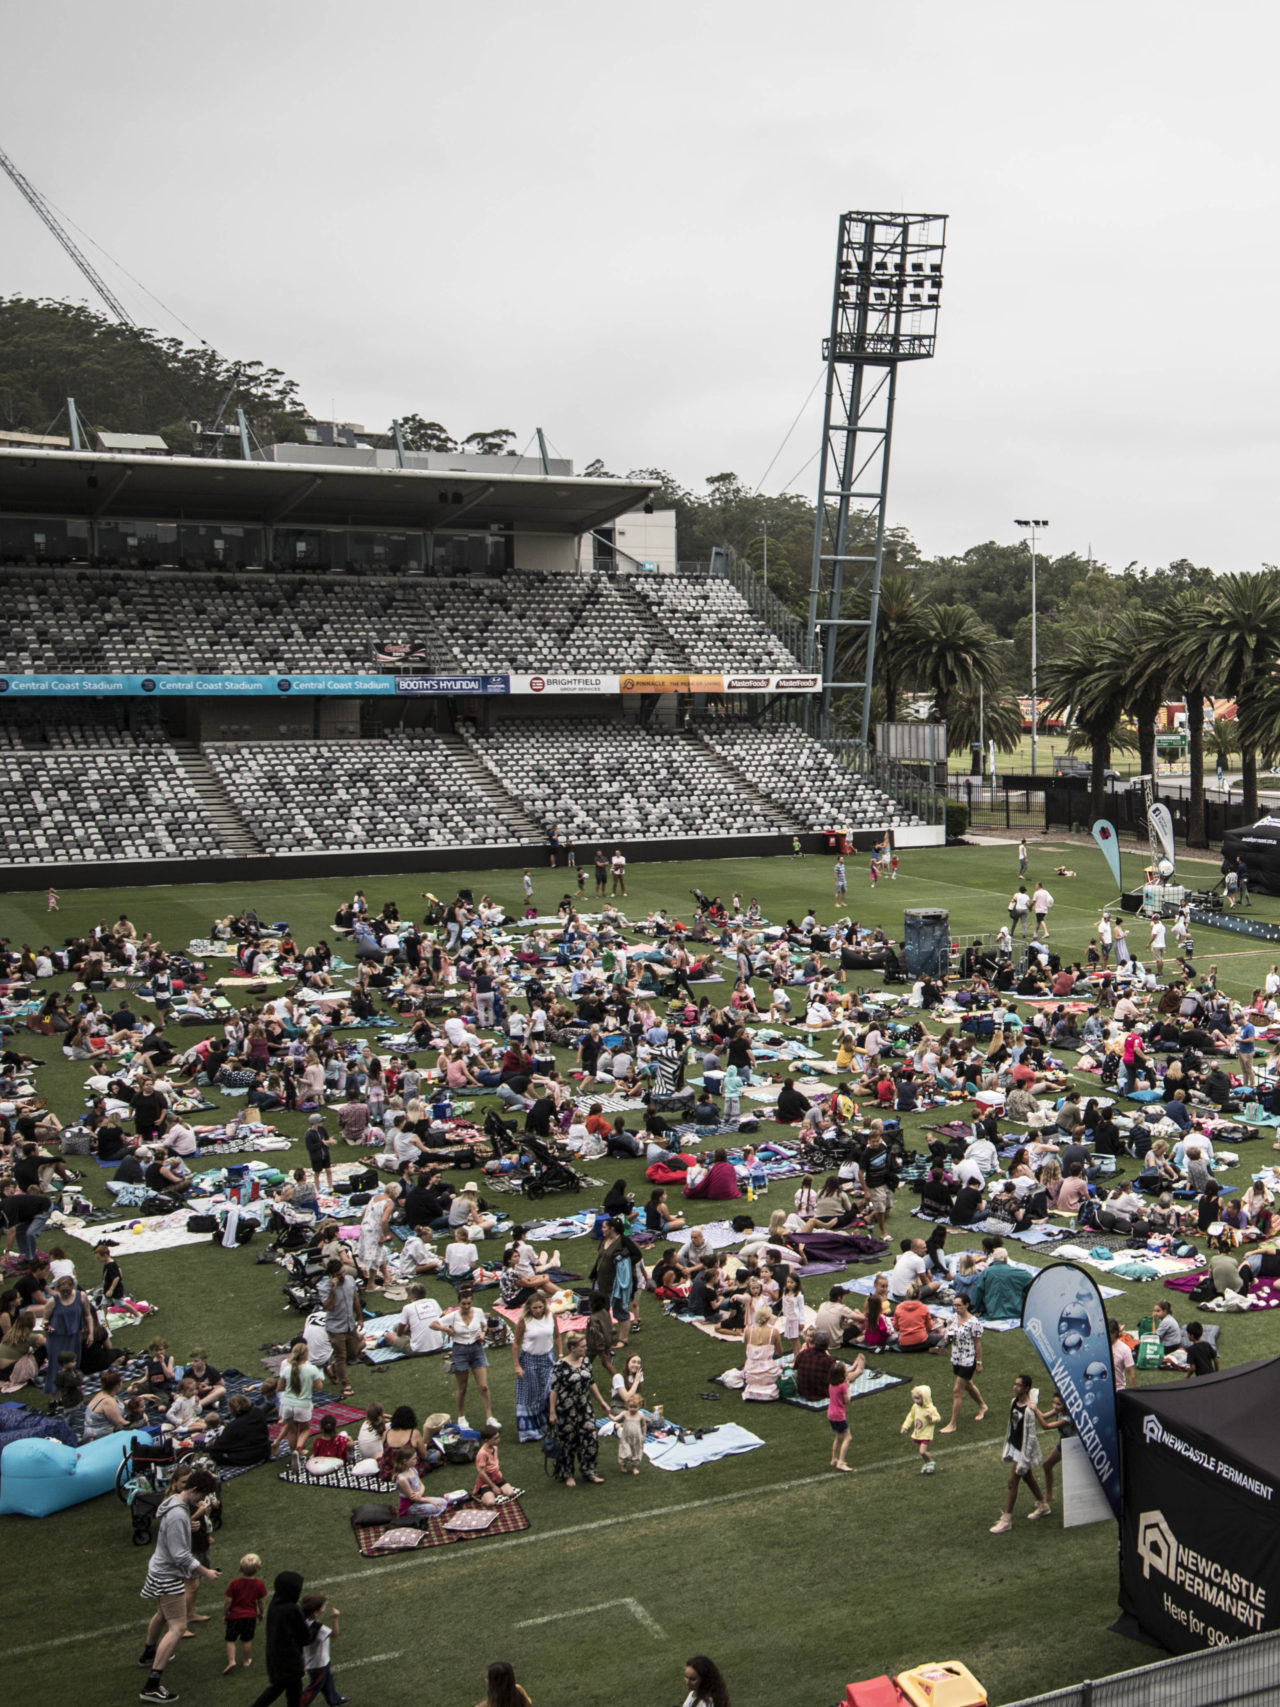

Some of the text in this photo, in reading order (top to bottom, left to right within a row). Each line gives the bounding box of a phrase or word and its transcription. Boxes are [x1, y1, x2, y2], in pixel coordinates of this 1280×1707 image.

[11, 681, 122, 690] Central Coast Stadium
[159, 681, 262, 690] Central Coast Stadium
[293, 680, 389, 690] Central Coast Stadium
[400, 680, 438, 690] BOOTH'S
[439, 681, 479, 690] HYUNDAI
[546, 678, 601, 686] BRIGHTFIELD
[1051, 1358, 1113, 1483] WATER STATION
[1162, 1430, 1274, 1501] NEWCASTLE PERMANENT
[1178, 1543, 1266, 1609] NEWCASTLE
[1176, 1566, 1265, 1631] PERMANENT
[1163, 1592, 1187, 1626] Here
[1189, 1609, 1205, 1636] for
